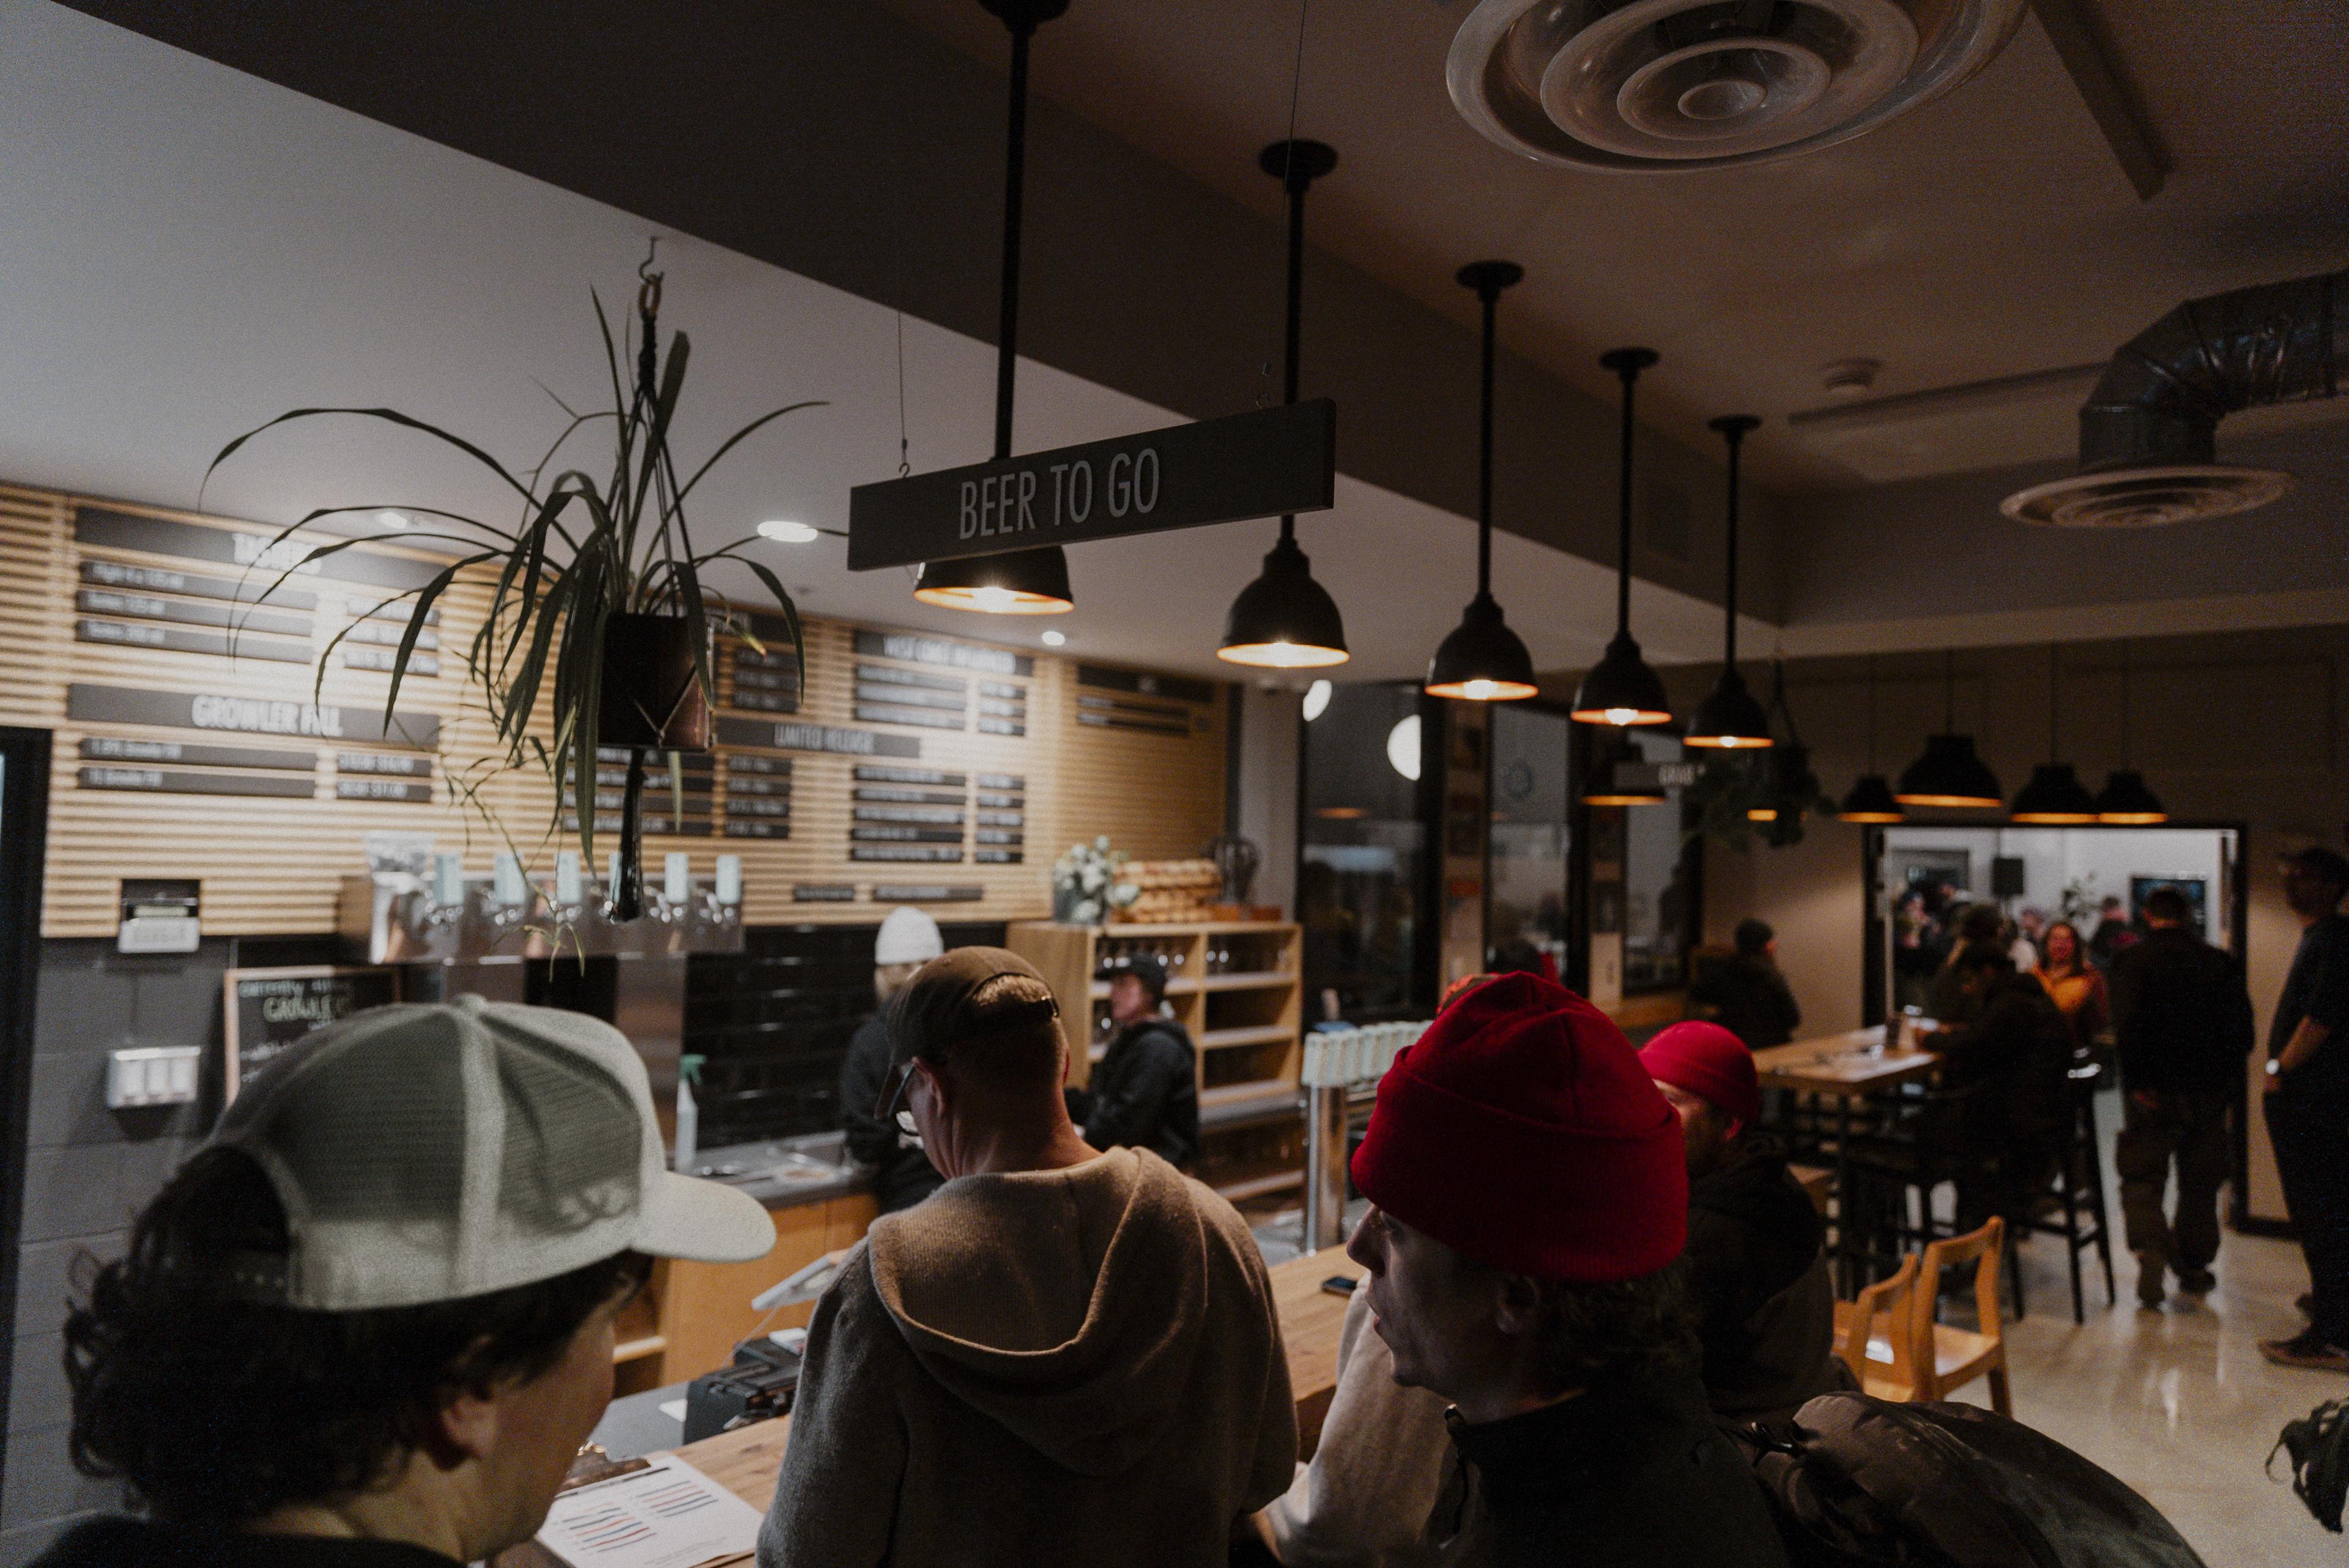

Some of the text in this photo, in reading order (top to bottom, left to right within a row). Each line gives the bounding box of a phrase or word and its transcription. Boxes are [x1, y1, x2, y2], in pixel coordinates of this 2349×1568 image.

[960, 448, 1159, 540] BEER TO GO
[192, 695, 299, 733] GROWLER
